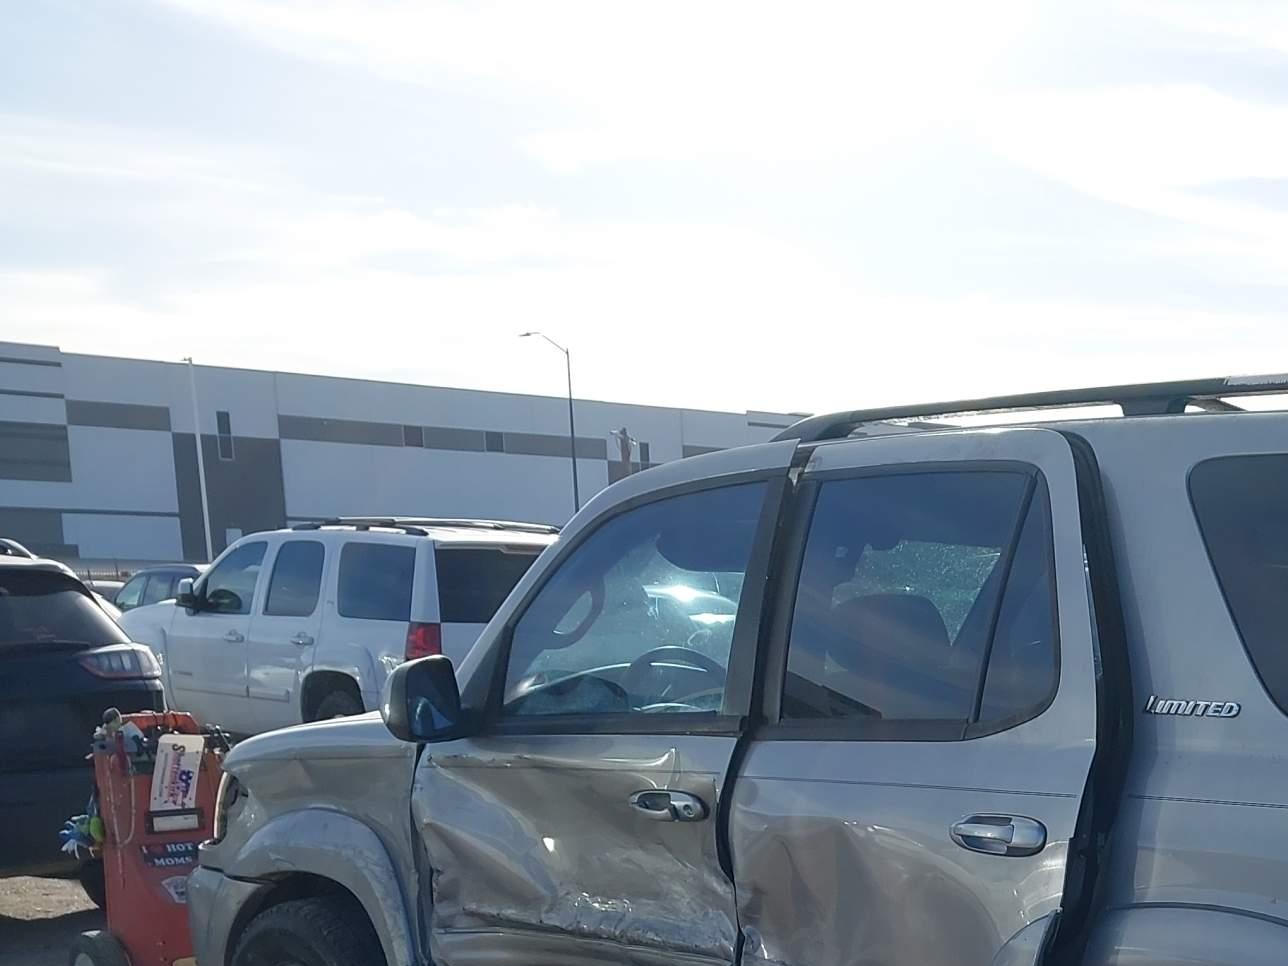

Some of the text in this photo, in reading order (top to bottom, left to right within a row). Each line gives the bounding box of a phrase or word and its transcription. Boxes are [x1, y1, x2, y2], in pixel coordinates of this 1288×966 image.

[1146, 695, 1241, 718] LIMITED
[165, 842, 194, 853] HOT
[154, 856, 193, 866] MOMS
